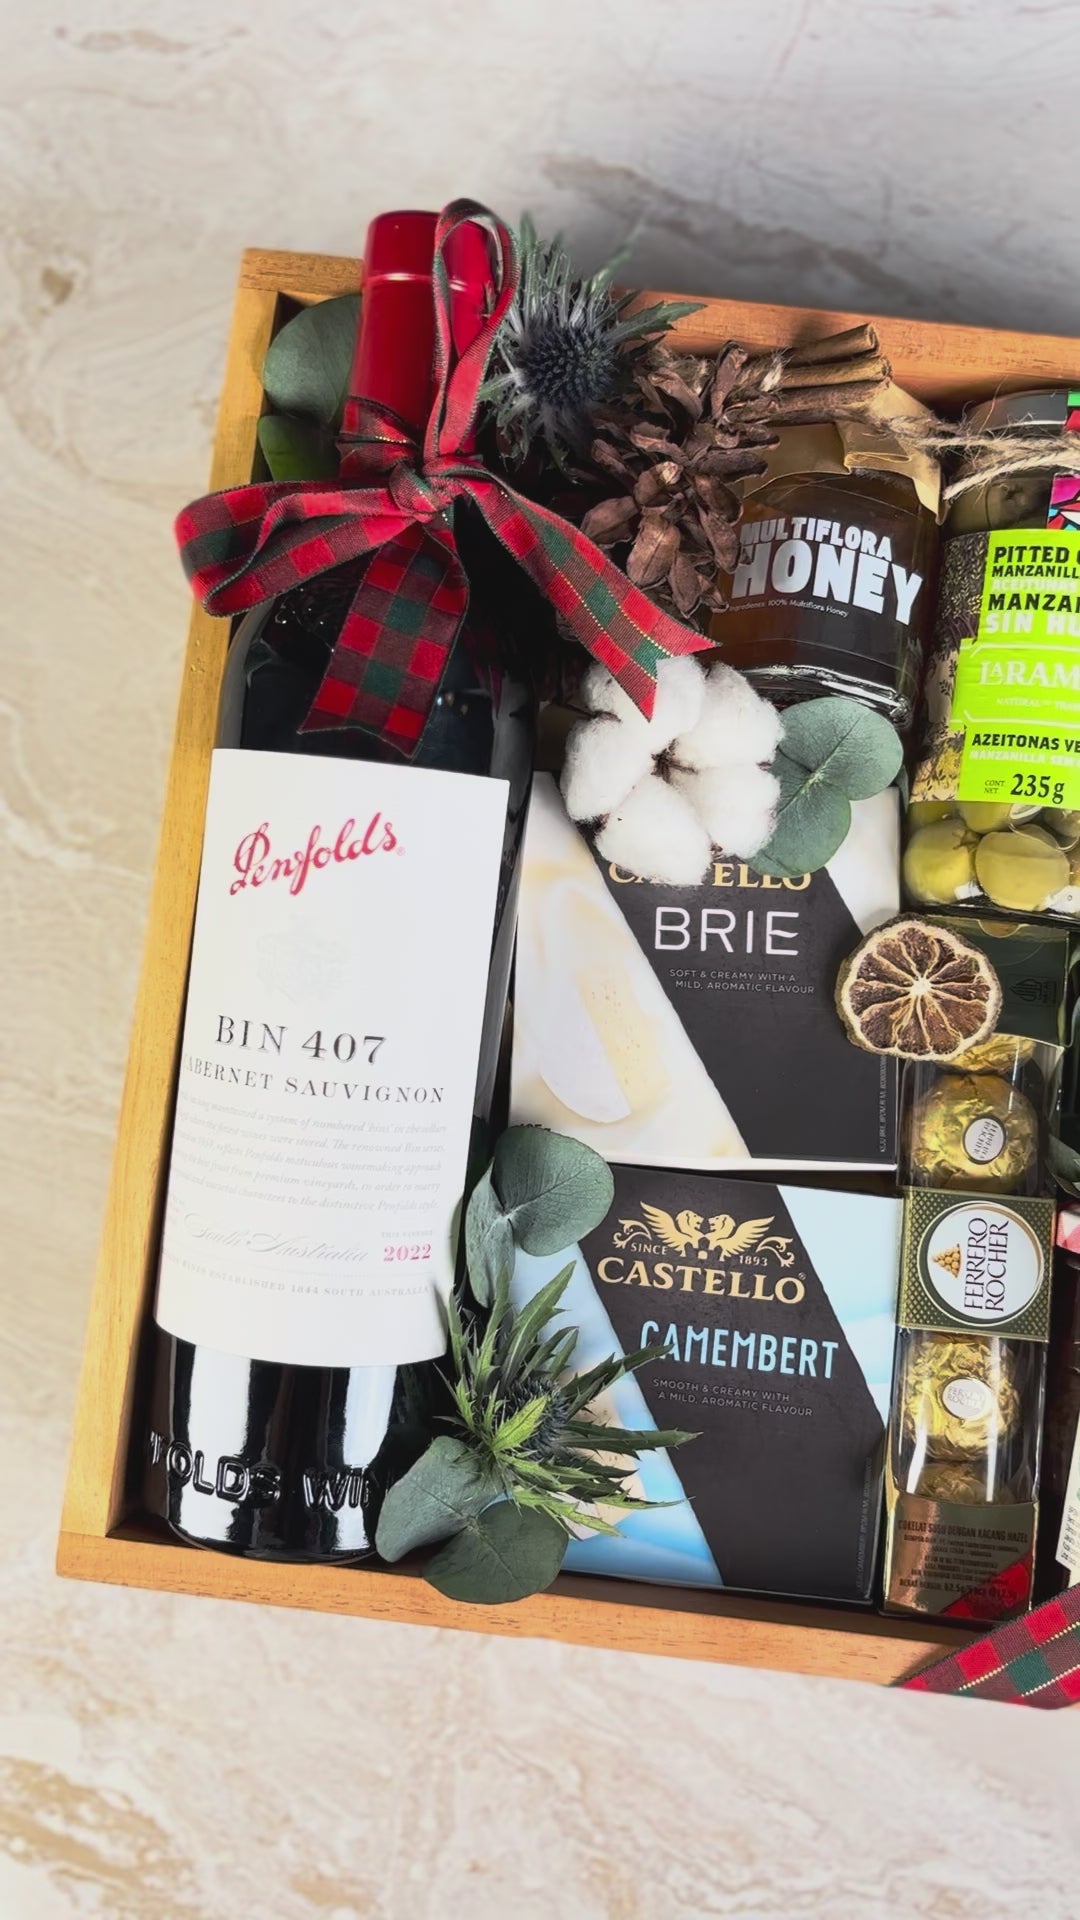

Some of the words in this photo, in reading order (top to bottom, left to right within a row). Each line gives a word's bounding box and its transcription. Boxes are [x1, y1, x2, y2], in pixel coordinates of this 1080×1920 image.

[739, 516, 893, 562] MULTIFLORA
[993, 545, 1070, 564] PITTED
[731, 539, 924, 626] HONEY
[825, 605, 850, 618] Honey
[985, 612, 1034, 634] SIN
[971, 733, 1060, 751] AZEITONAS
[229, 812, 398, 896] Penfolds
[655, 906, 800, 956] BRIE
[669, 968, 697, 978] SOFT
[700, 970, 708, 979] &
[710, 970, 754, 980] CREAMY
[758, 973, 786, 982] WITH
[788, 974, 796, 983] A
[707, 981, 763, 993] AROMATIC
[765, 983, 815, 995] FLAVOUR
[215, 1014, 288, 1056] BIN
[300, 1029, 388, 1066] 407
[284, 1076, 446, 1104] SAUVIGNON
[383, 1243, 433, 1263] 2022
[630, 1242, 668, 1256] SINCE
[738, 1255, 769, 1267] 1893
[964, 1217, 989, 1311] FERRERO
[984, 1219, 1010, 1313] ROCHER
[597, 1256, 806, 1305] CASTELLO
[640, 1320, 839, 1379] CAMEMBERT
[652, 1378, 699, 1392] SMOOTH
[702, 1383, 710, 1393] &
[712, 1385, 758, 1400] CREAMY
[761, 1390, 791, 1402] WITH
[658, 1391, 667, 1401] A
[701, 1395, 760, 1411] AROMATIC
[762, 1402, 814, 1417] FLAVOUR
